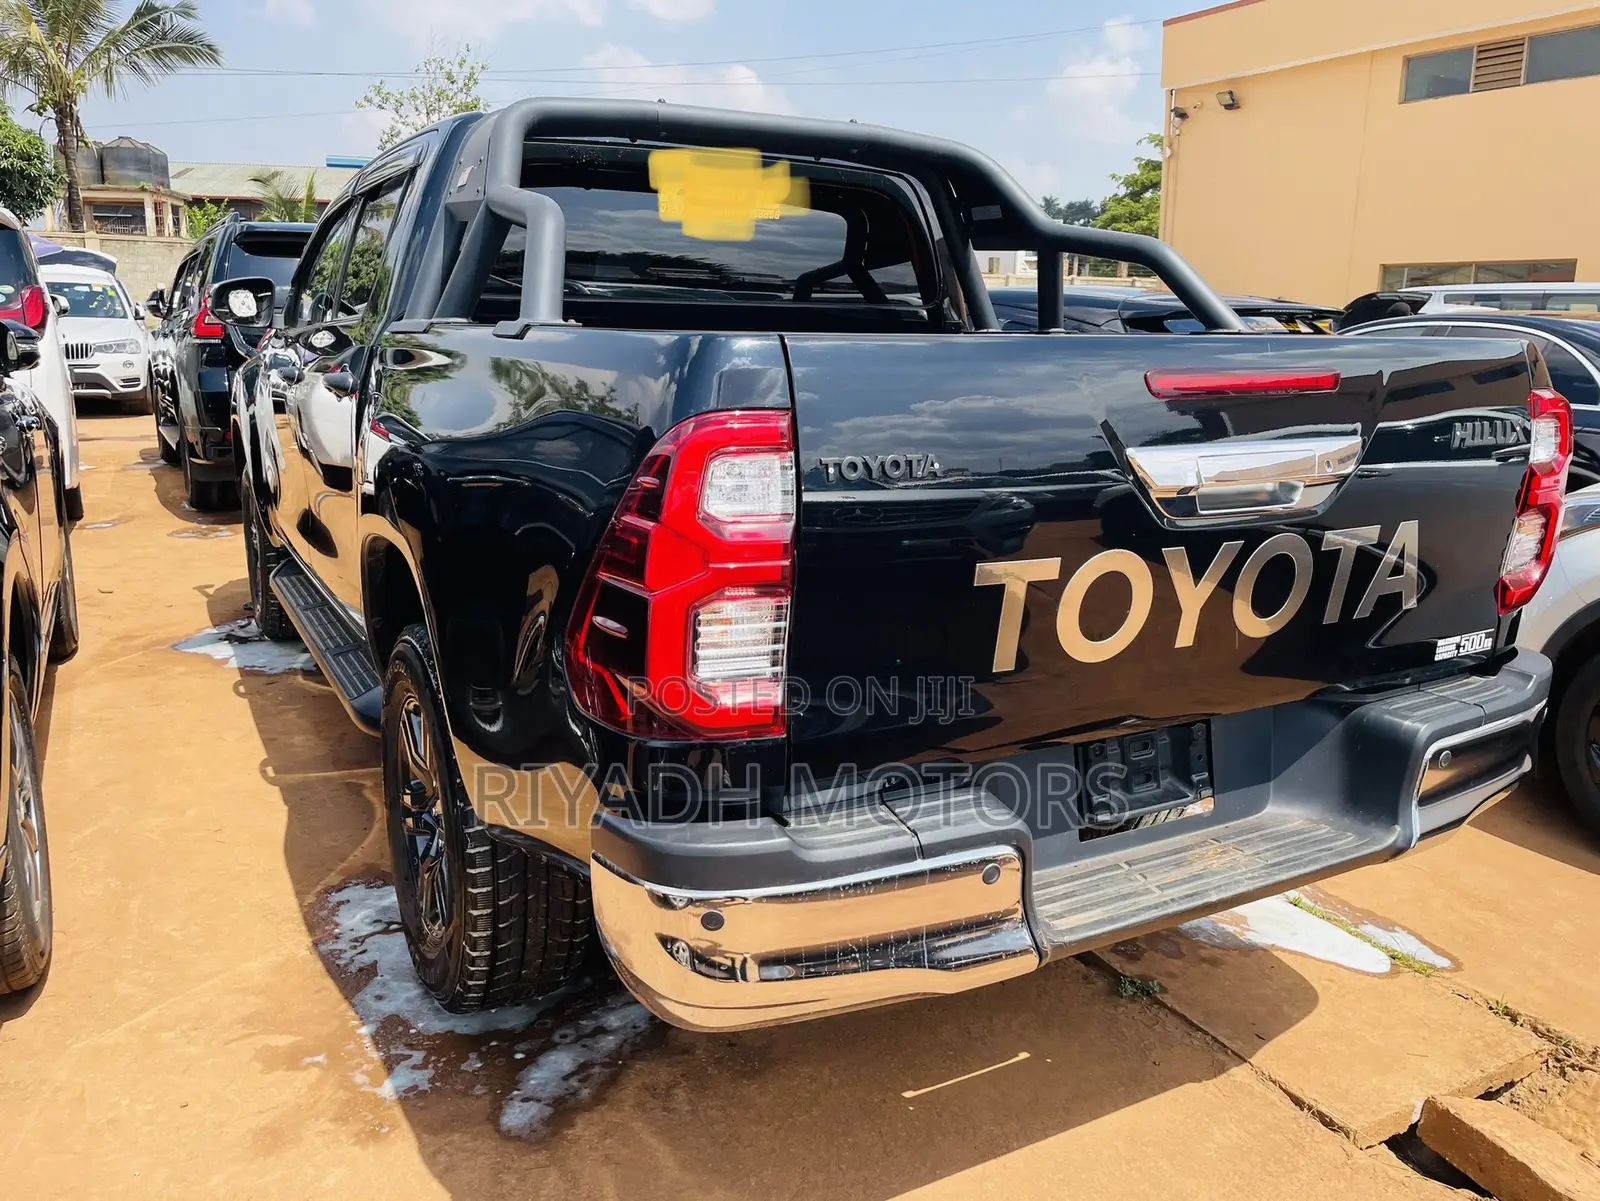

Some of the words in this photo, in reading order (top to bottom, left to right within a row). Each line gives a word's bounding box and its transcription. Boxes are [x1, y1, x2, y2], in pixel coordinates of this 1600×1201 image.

[1451, 419, 1530, 449] HILUX
[820, 454, 942, 484] TOYOTA
[974, 519, 1419, 673] TOYOTA
